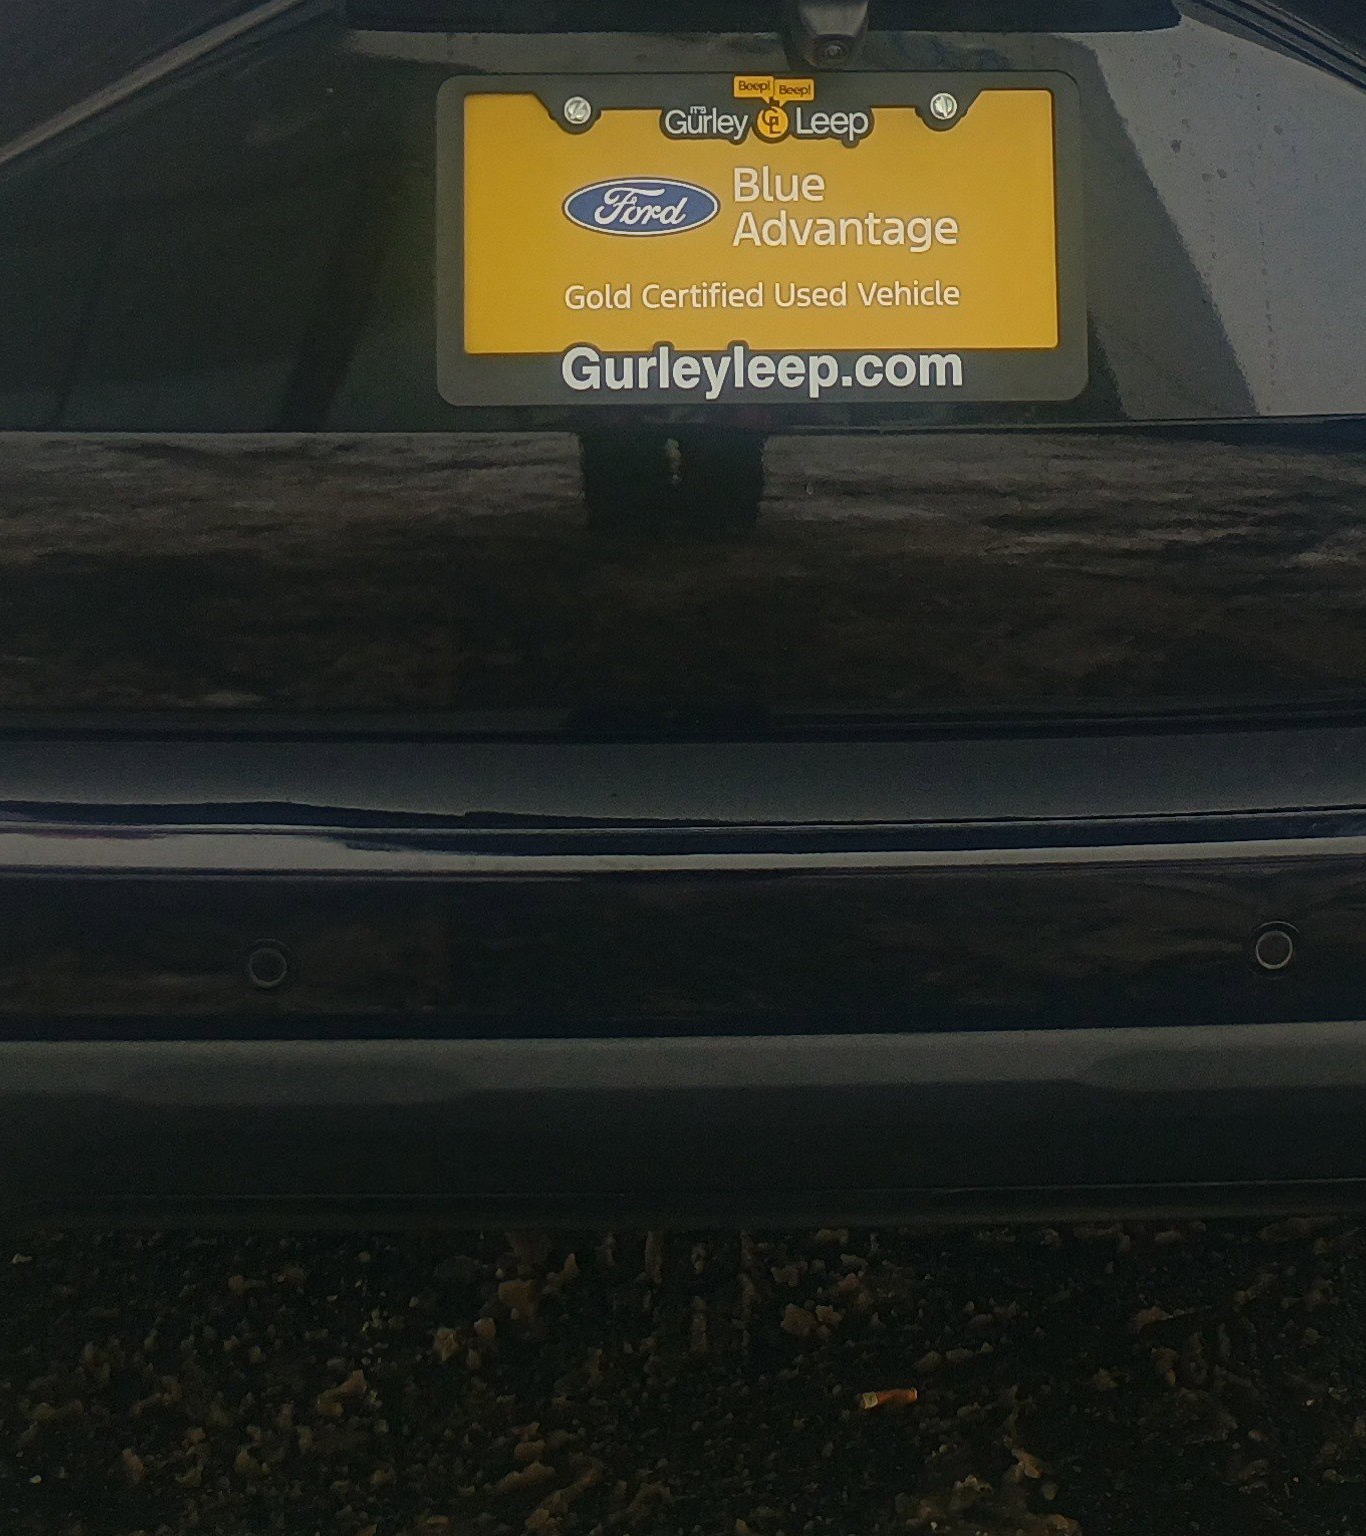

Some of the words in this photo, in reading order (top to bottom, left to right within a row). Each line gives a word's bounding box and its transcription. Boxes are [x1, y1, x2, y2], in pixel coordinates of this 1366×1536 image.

[738, 80, 771, 93] Beep!
[778, 85, 811, 97] Beep!
[664, 106, 749, 141] Gurley
[796, 106, 870, 141] Leep
[733, 166, 826, 203] Blue
[593, 183, 688, 229] Ford
[732, 211, 960, 253] Advantage
[564, 282, 632, 311] Gold
[641, 281, 764, 310] Certified
[773, 280, 848, 309] Used
[857, 278, 961, 307] Vehicle
[561, 344, 964, 400] Gurleyleep.com
